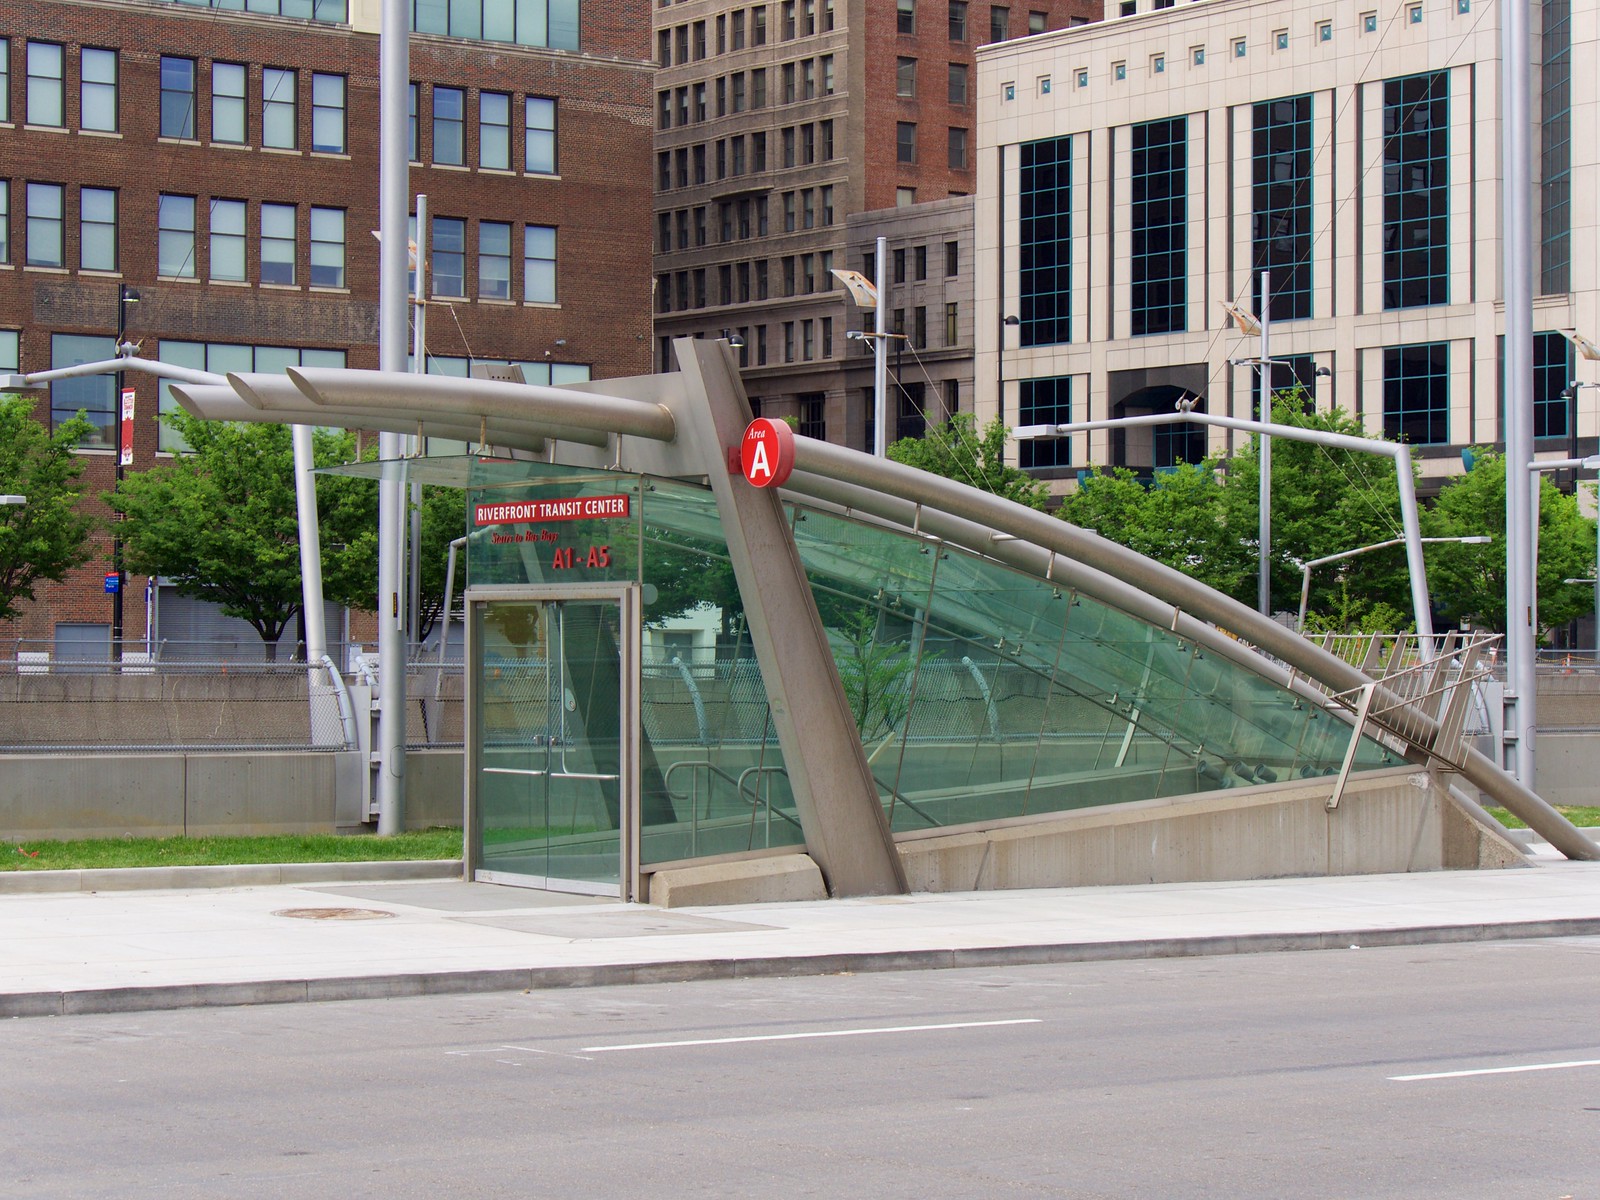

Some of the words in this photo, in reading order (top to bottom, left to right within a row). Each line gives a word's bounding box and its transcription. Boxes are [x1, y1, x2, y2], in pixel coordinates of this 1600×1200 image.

[748, 428, 766, 439] Area
[750, 441, 771, 478] A
[477, 504, 537, 521] RIVERFRONT
[539, 501, 582, 517] TRANSIT
[585, 498, 625, 515] CENTER
[491, 532, 513, 545] Stairs
[514, 533, 523, 543] to
[525, 530, 539, 542] Bus
[541, 529, 559, 545] Bays
[552, 547, 574, 569] A1
[586, 545, 611, 568] A5
